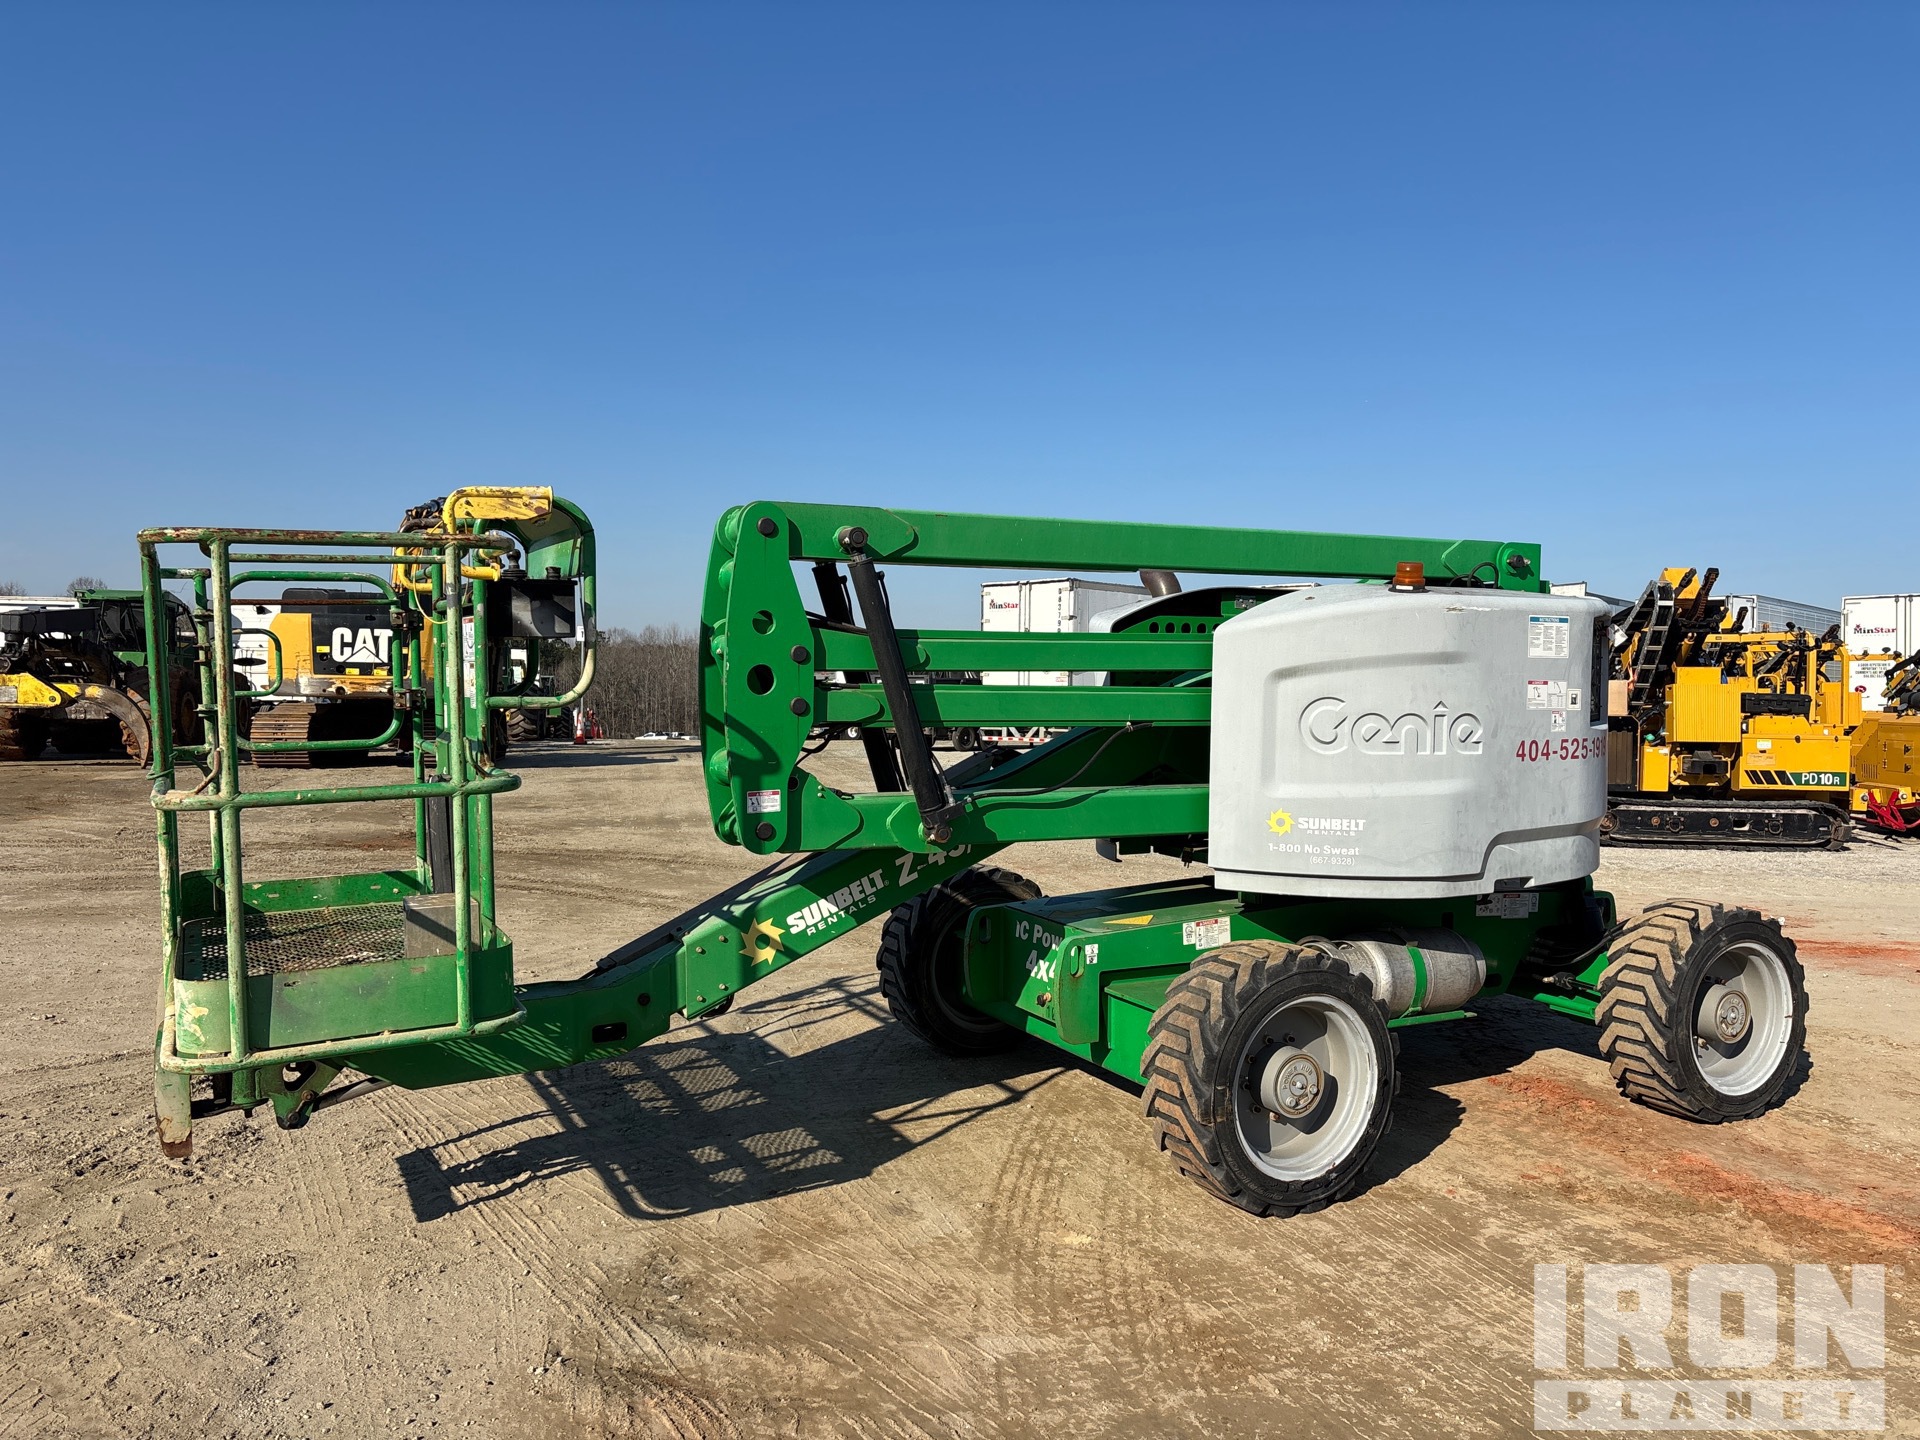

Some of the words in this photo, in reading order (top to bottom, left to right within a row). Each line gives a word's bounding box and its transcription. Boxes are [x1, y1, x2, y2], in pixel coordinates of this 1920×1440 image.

[989, 600, 1019, 609] MinStar
[1854, 626, 1897, 634] MinStar
[332, 627, 394, 664] CAT
[1299, 696, 1483, 755] Genie
[1297, 817, 1366, 831] SUNBELT
[1268, 842, 1301, 853] 1-800
[1304, 844, 1320, 854] No
[1323, 845, 1360, 856] Sweat
[1310, 855, 1355, 866] (667-9328)
[786, 868, 885, 935] SUNBELT
[806, 895, 877, 936] RENTALS
[1282, 1065, 1298, 1090] POWER
[1300, 1063, 1314, 1076] HUB
